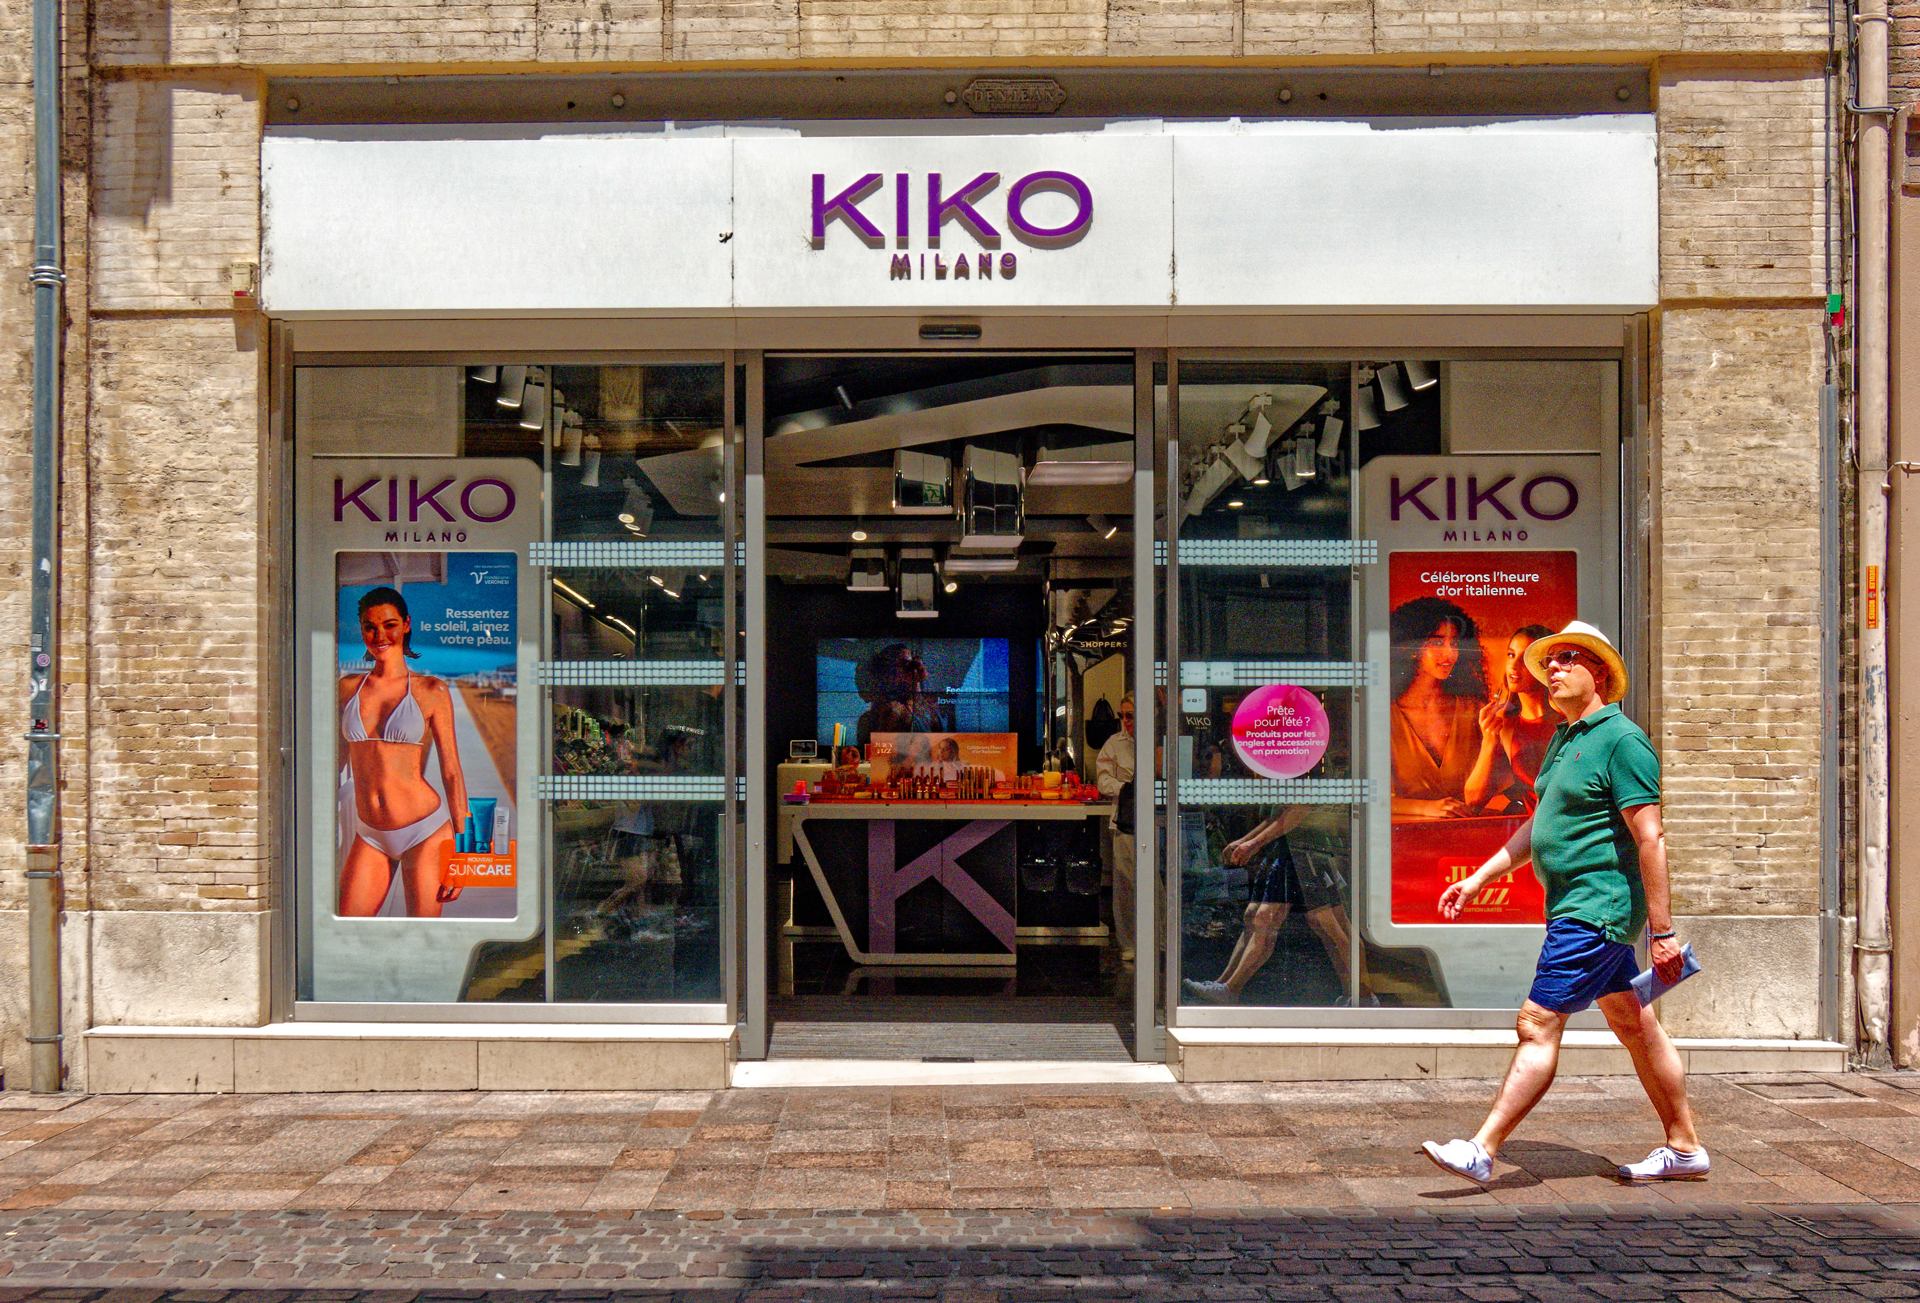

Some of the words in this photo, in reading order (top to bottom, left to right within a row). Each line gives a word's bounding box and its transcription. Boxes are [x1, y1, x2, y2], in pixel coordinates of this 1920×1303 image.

[811, 170, 1094, 248] KIKO
[890, 252, 1017, 275] MILANO
[333, 478, 516, 523] KIKO
[1390, 475, 1579, 521] KIKO
[384, 531, 467, 543] MILANO
[1443, 530, 1529, 542] MILANO
[1420, 571, 1491, 583] Célébrons
[1493, 571, 1540, 583] l'heure
[1436, 584, 1463, 597] d'or
[1465, 584, 1528, 597] italienne.
[445, 607, 510, 619] Ressentez
[420, 620, 432, 632] le
[434, 620, 470, 633] soleil,
[471, 620, 510, 632] aimez
[440, 634, 474, 645] votre
[477, 635, 512, 647] peau.
[1267, 705, 1295, 716] Prête
[1185, 716, 1212, 726] KIKO
[1254, 718, 1281, 729] pour
[1282, 716, 1304, 727] l'été
[1304, 716, 1311, 727] ?
[1246, 730, 1281, 738] Produits
[1282, 731, 1303, 739] pour
[1304, 730, 1316, 738] les
[1238, 739, 1266, 749] ongles
[1266, 739, 1276, 747] et
[1276, 738, 1325, 747] accessoires
[1252, 748, 1264, 756] en
[1264, 747, 1310, 757] promotion
[449, 863, 512, 876] SUNCARE
